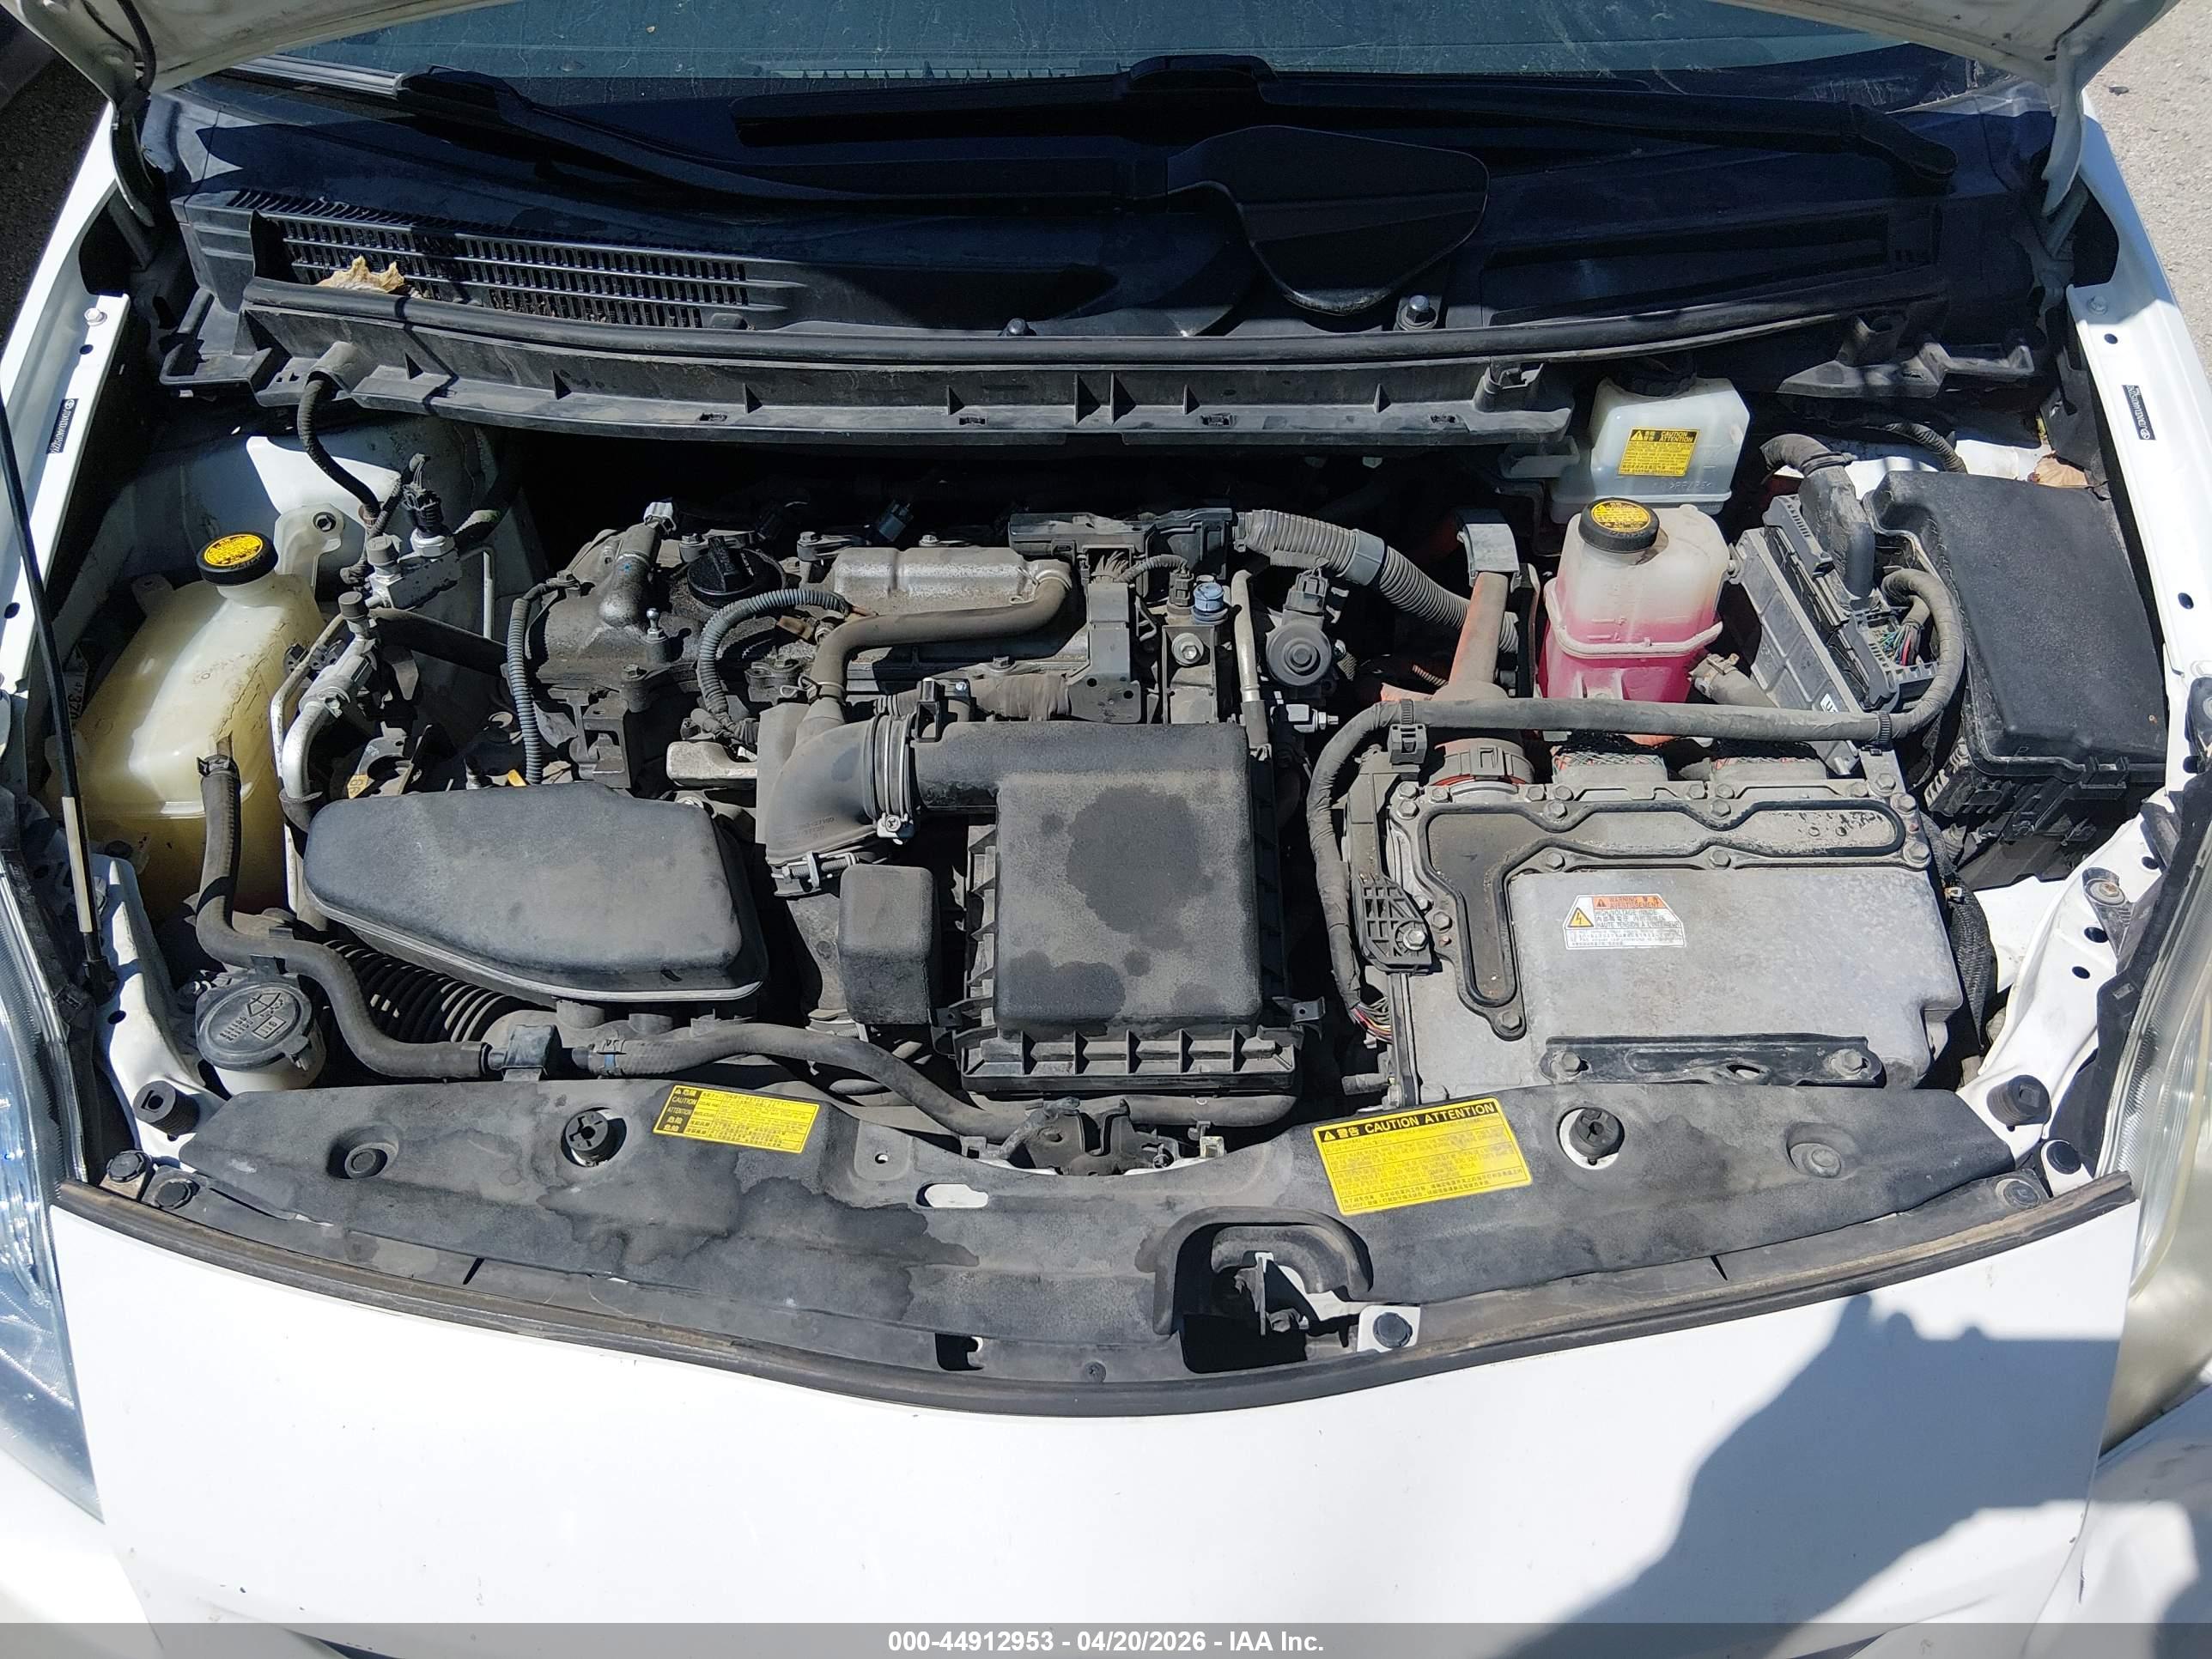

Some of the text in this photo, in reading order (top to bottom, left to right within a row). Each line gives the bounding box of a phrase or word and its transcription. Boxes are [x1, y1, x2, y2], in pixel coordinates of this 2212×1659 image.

[667, 1107, 692, 1115] ATTENTION
[1337, 1103, 1496, 1139] 警告 CAUTION ATTENTION
